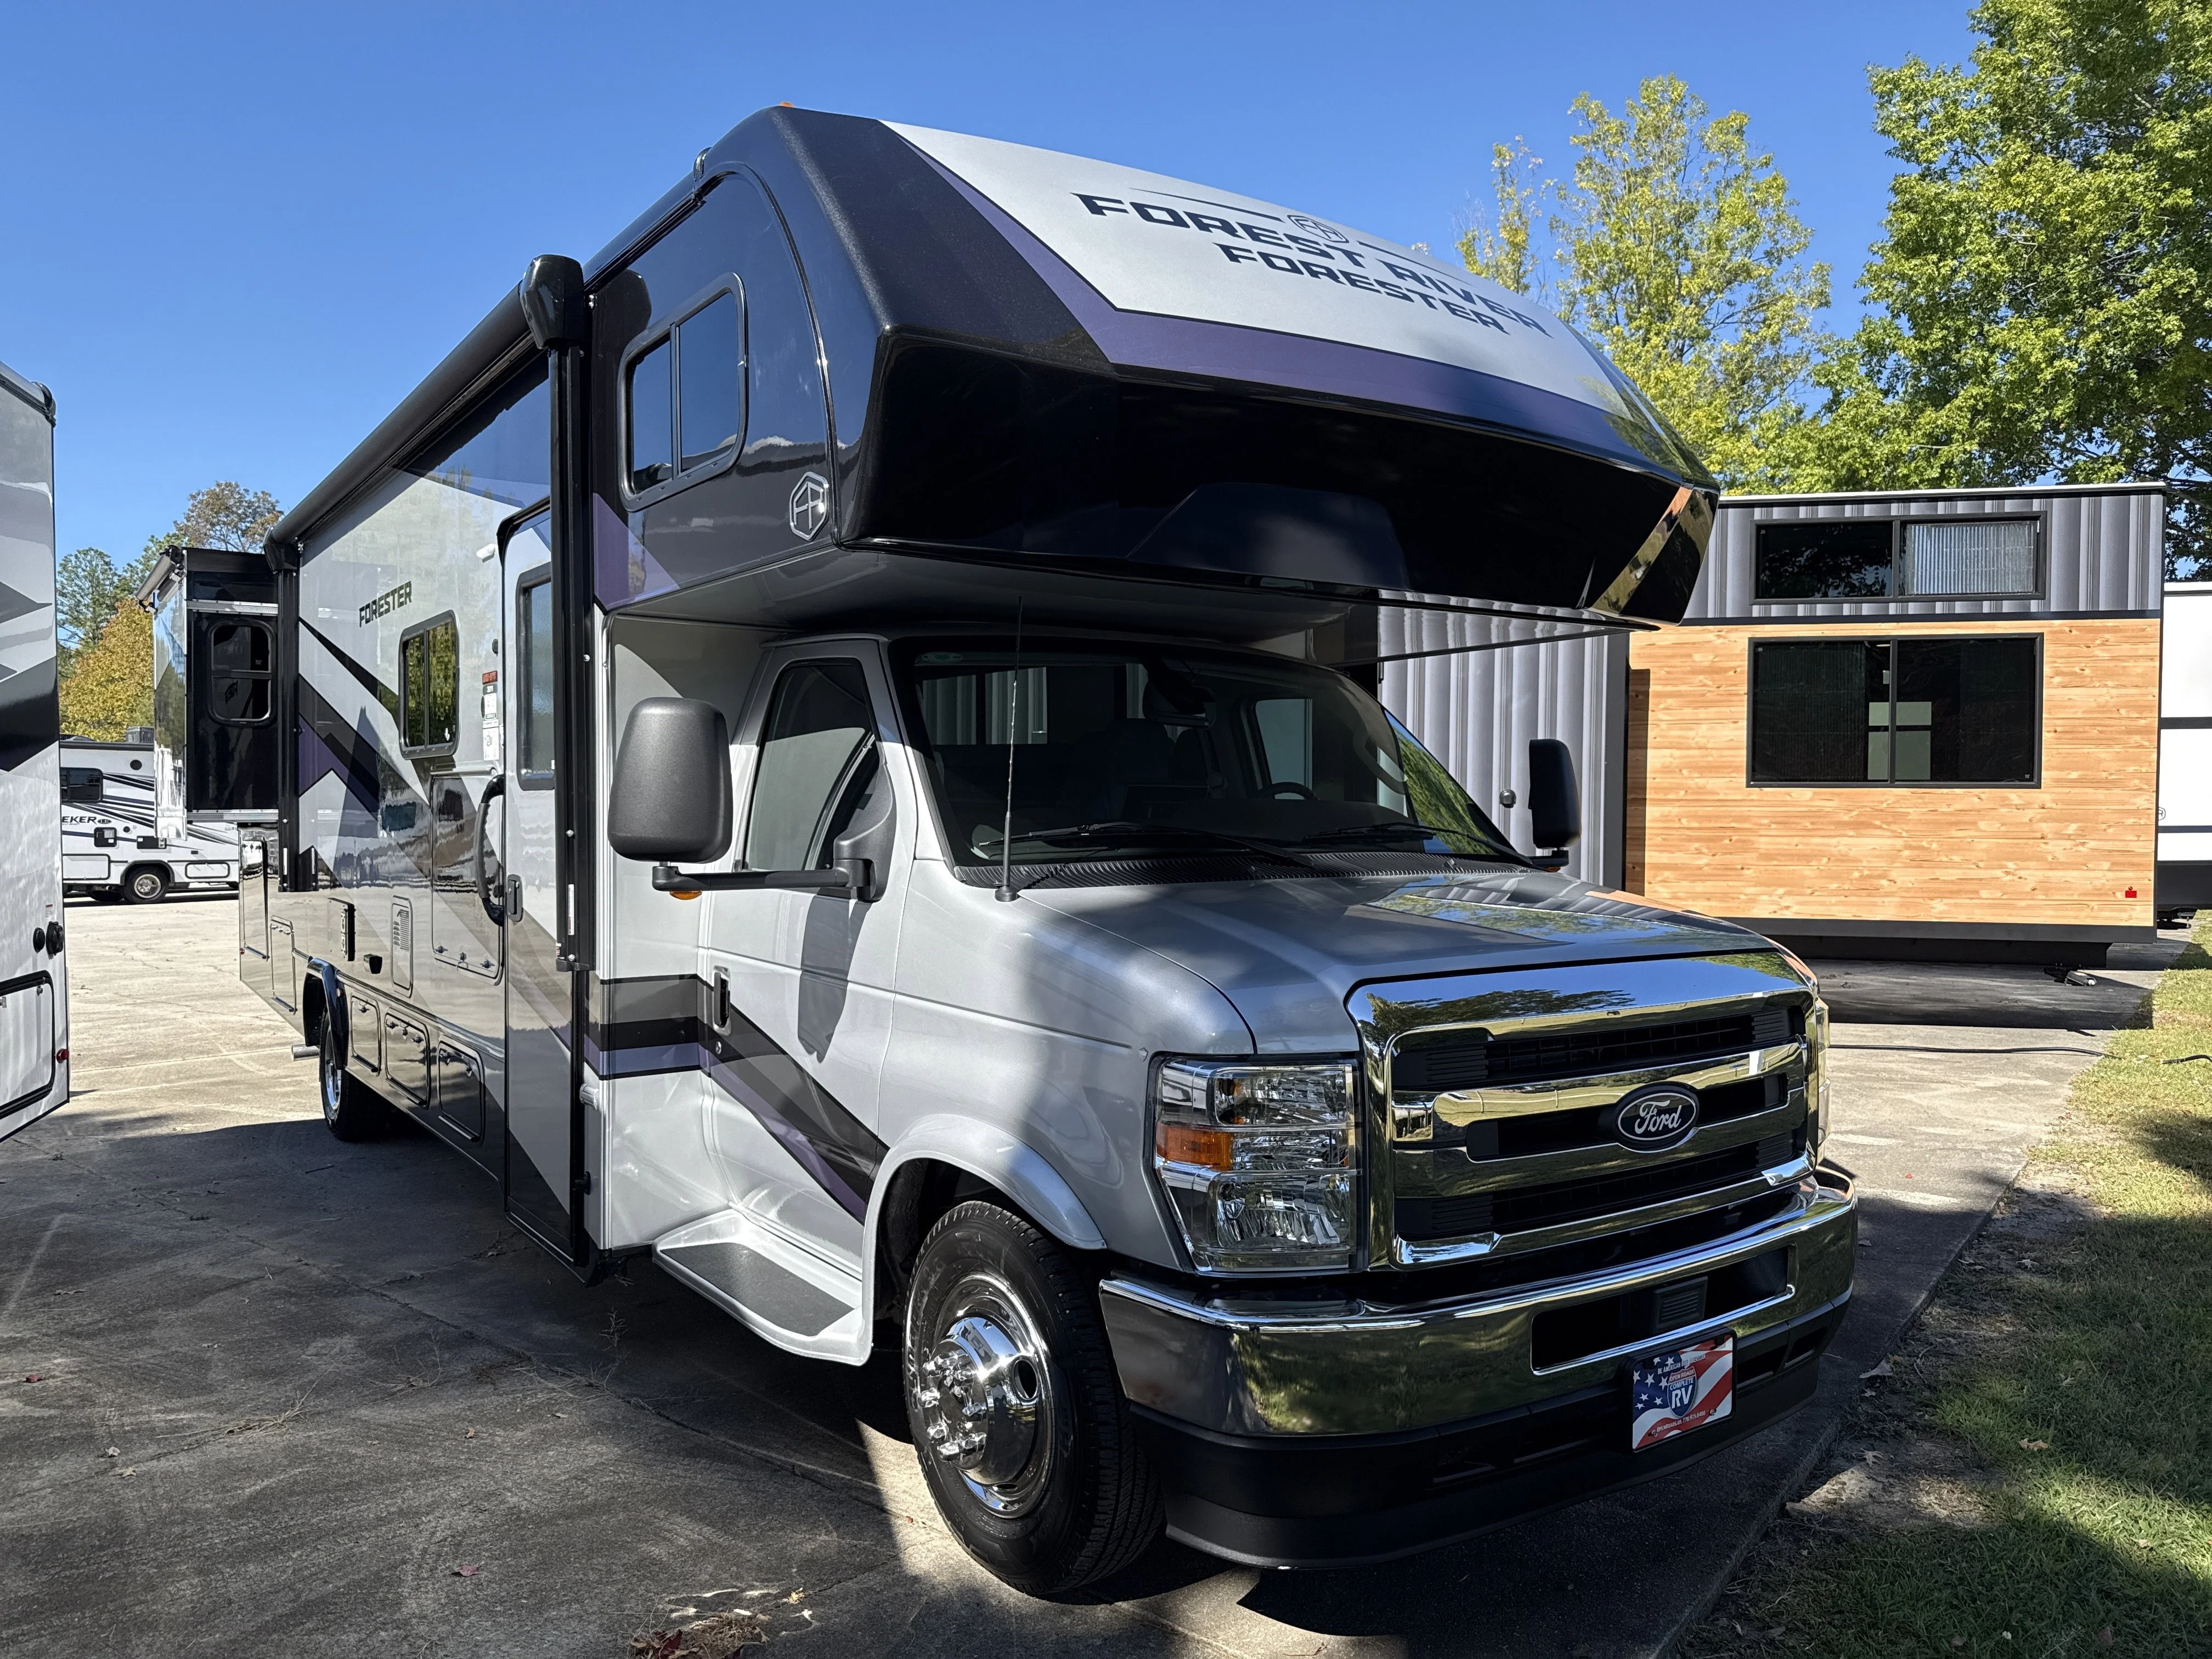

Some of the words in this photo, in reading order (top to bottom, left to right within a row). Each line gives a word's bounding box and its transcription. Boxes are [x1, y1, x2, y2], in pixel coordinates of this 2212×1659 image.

[1069, 192, 1366, 269] FOREST
[1375, 258, 1555, 339] RIVER
[1212, 242, 1511, 336] FORESTER
[359, 580, 412, 628] FORESTER
[61, 816, 97, 825] EKER
[1634, 1099, 1682, 1135] Ford
[1663, 1362, 1681, 1373] AMERICAN
[1669, 1373, 1680, 1381] OPEN
[1681, 1369, 1694, 1378] ROADS
[1669, 1378, 1694, 1390] COMPLETE
[1672, 1385, 1693, 1409] RV
